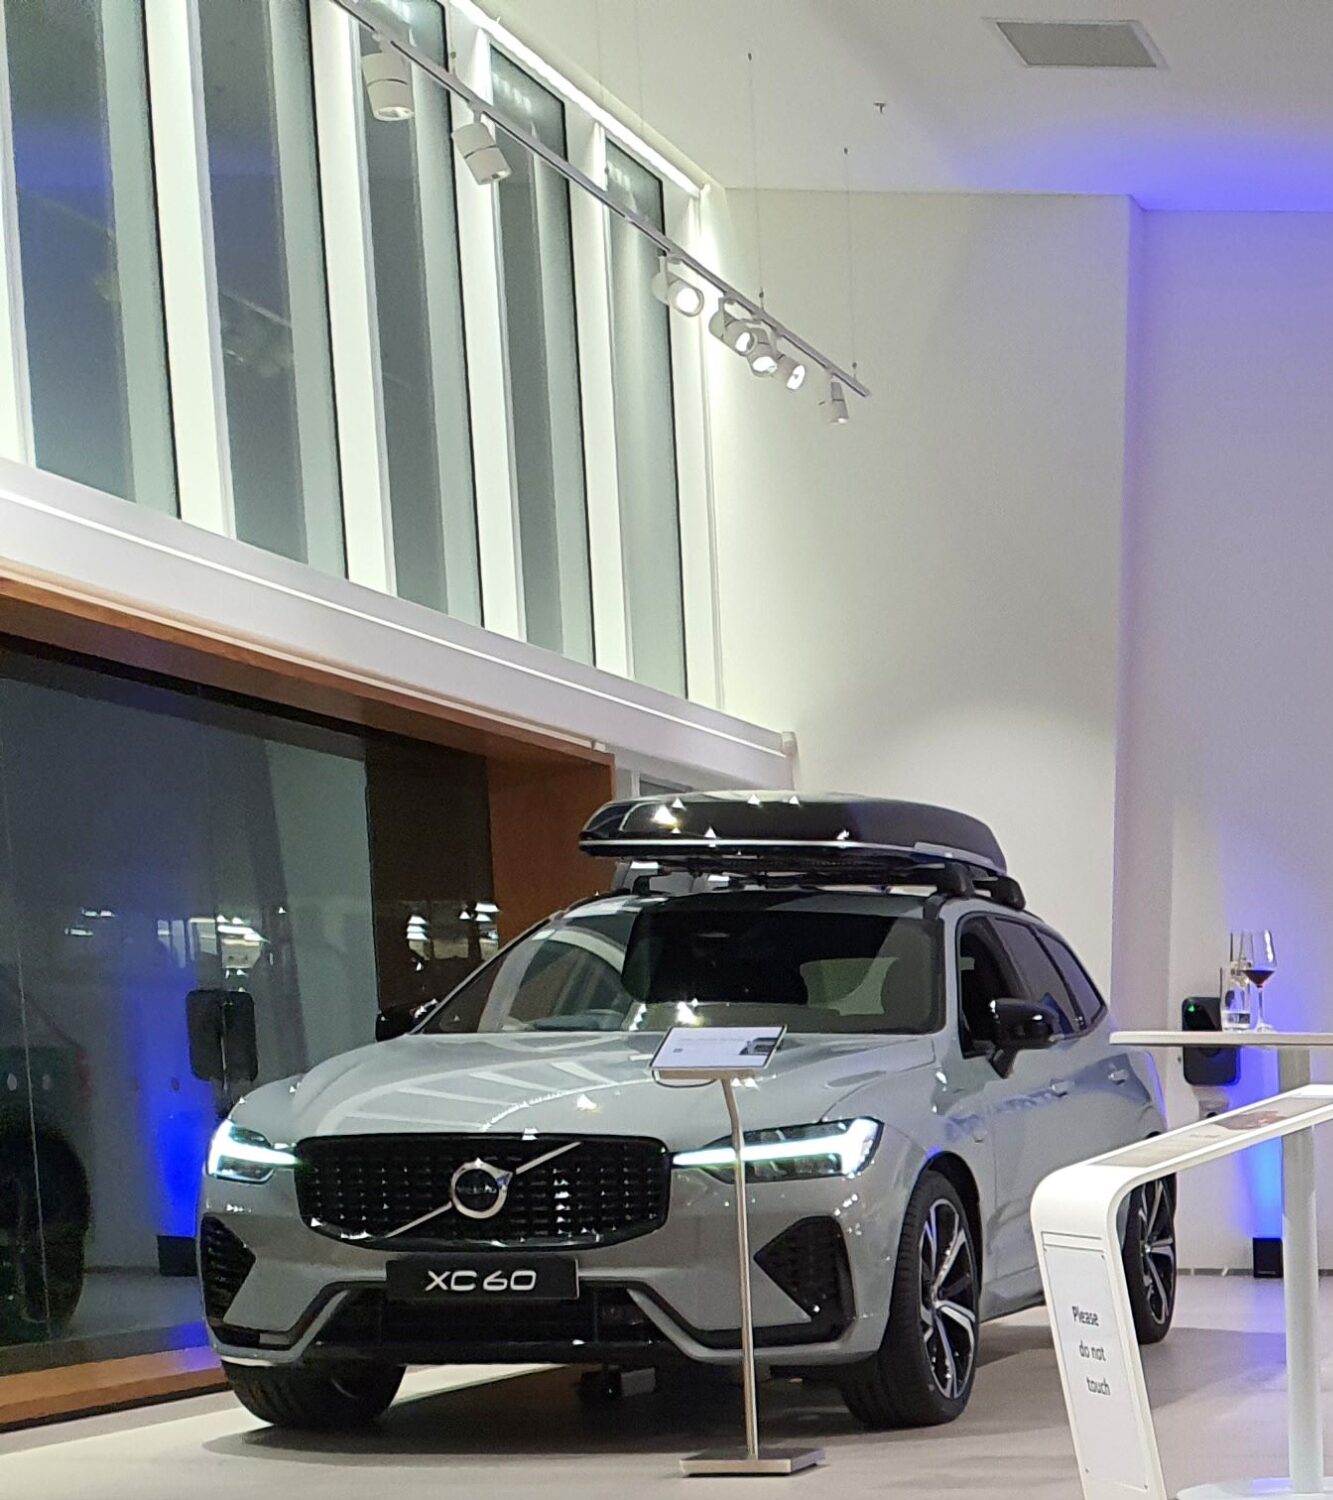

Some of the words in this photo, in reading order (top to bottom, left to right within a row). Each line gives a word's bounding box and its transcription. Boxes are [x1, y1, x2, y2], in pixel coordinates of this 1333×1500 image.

[1072, 1306, 1099, 1326] Please
[1079, 1340, 1090, 1358] do
[1091, 1347, 1106, 1361] not
[1086, 1376, 1110, 1395] touch
